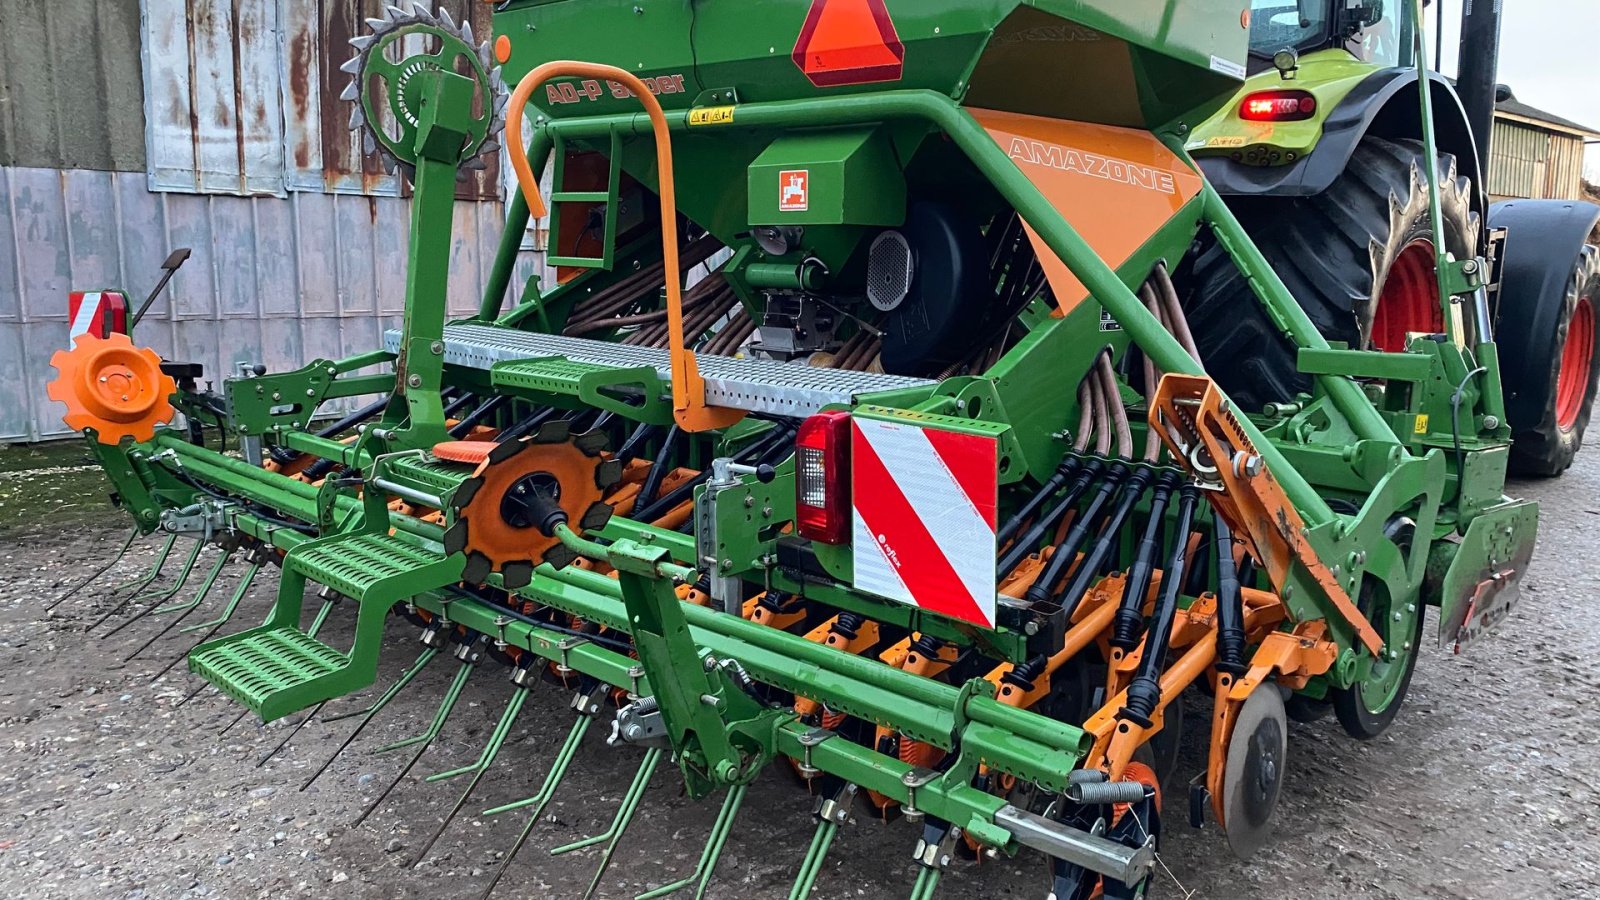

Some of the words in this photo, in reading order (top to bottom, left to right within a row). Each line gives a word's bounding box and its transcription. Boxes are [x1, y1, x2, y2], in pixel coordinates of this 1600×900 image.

[545, 79, 603, 106] AD-P
[605, 73, 686, 99] Sper
[1008, 138, 1176, 195] AMAZONE
[884, 543, 902, 569] reflex
